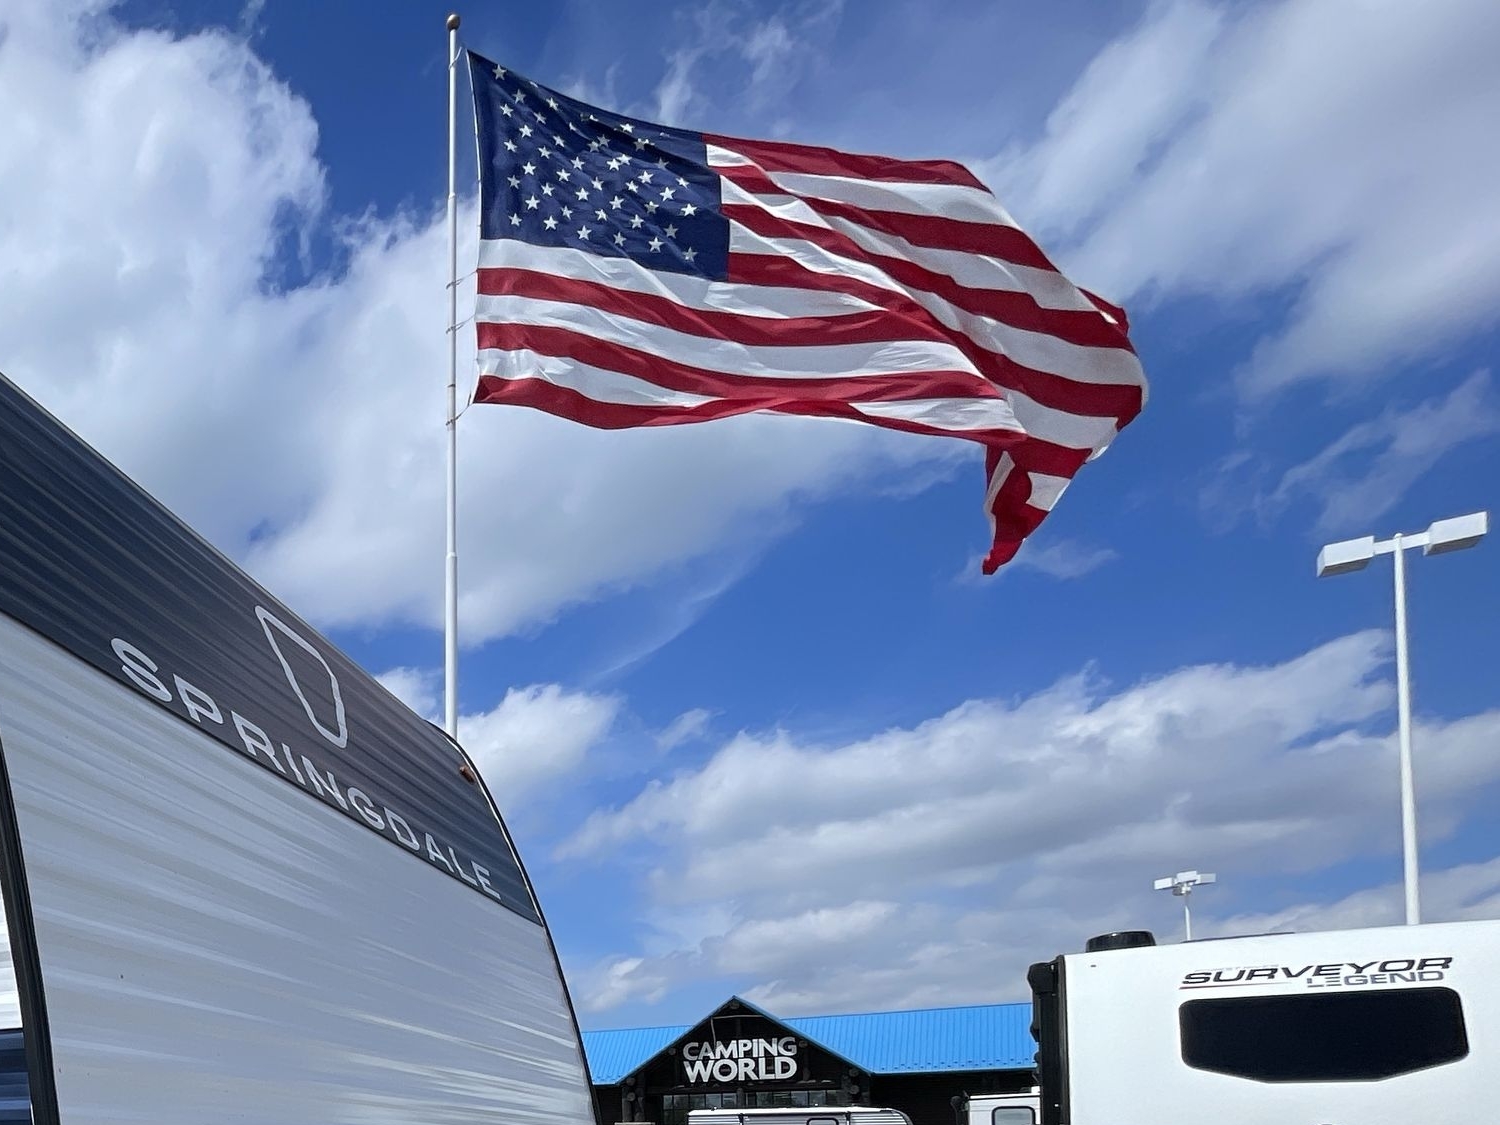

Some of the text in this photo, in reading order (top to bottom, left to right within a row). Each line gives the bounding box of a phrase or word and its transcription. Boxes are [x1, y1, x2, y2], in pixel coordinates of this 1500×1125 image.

[110, 637, 501, 900] SPRINGDALE
[1182, 956, 1454, 984] SURVEYOR
[1306, 970, 1444, 988] LEGEND
[683, 1036, 797, 1061] CAMPING
[683, 1057, 797, 1083] WORLD
